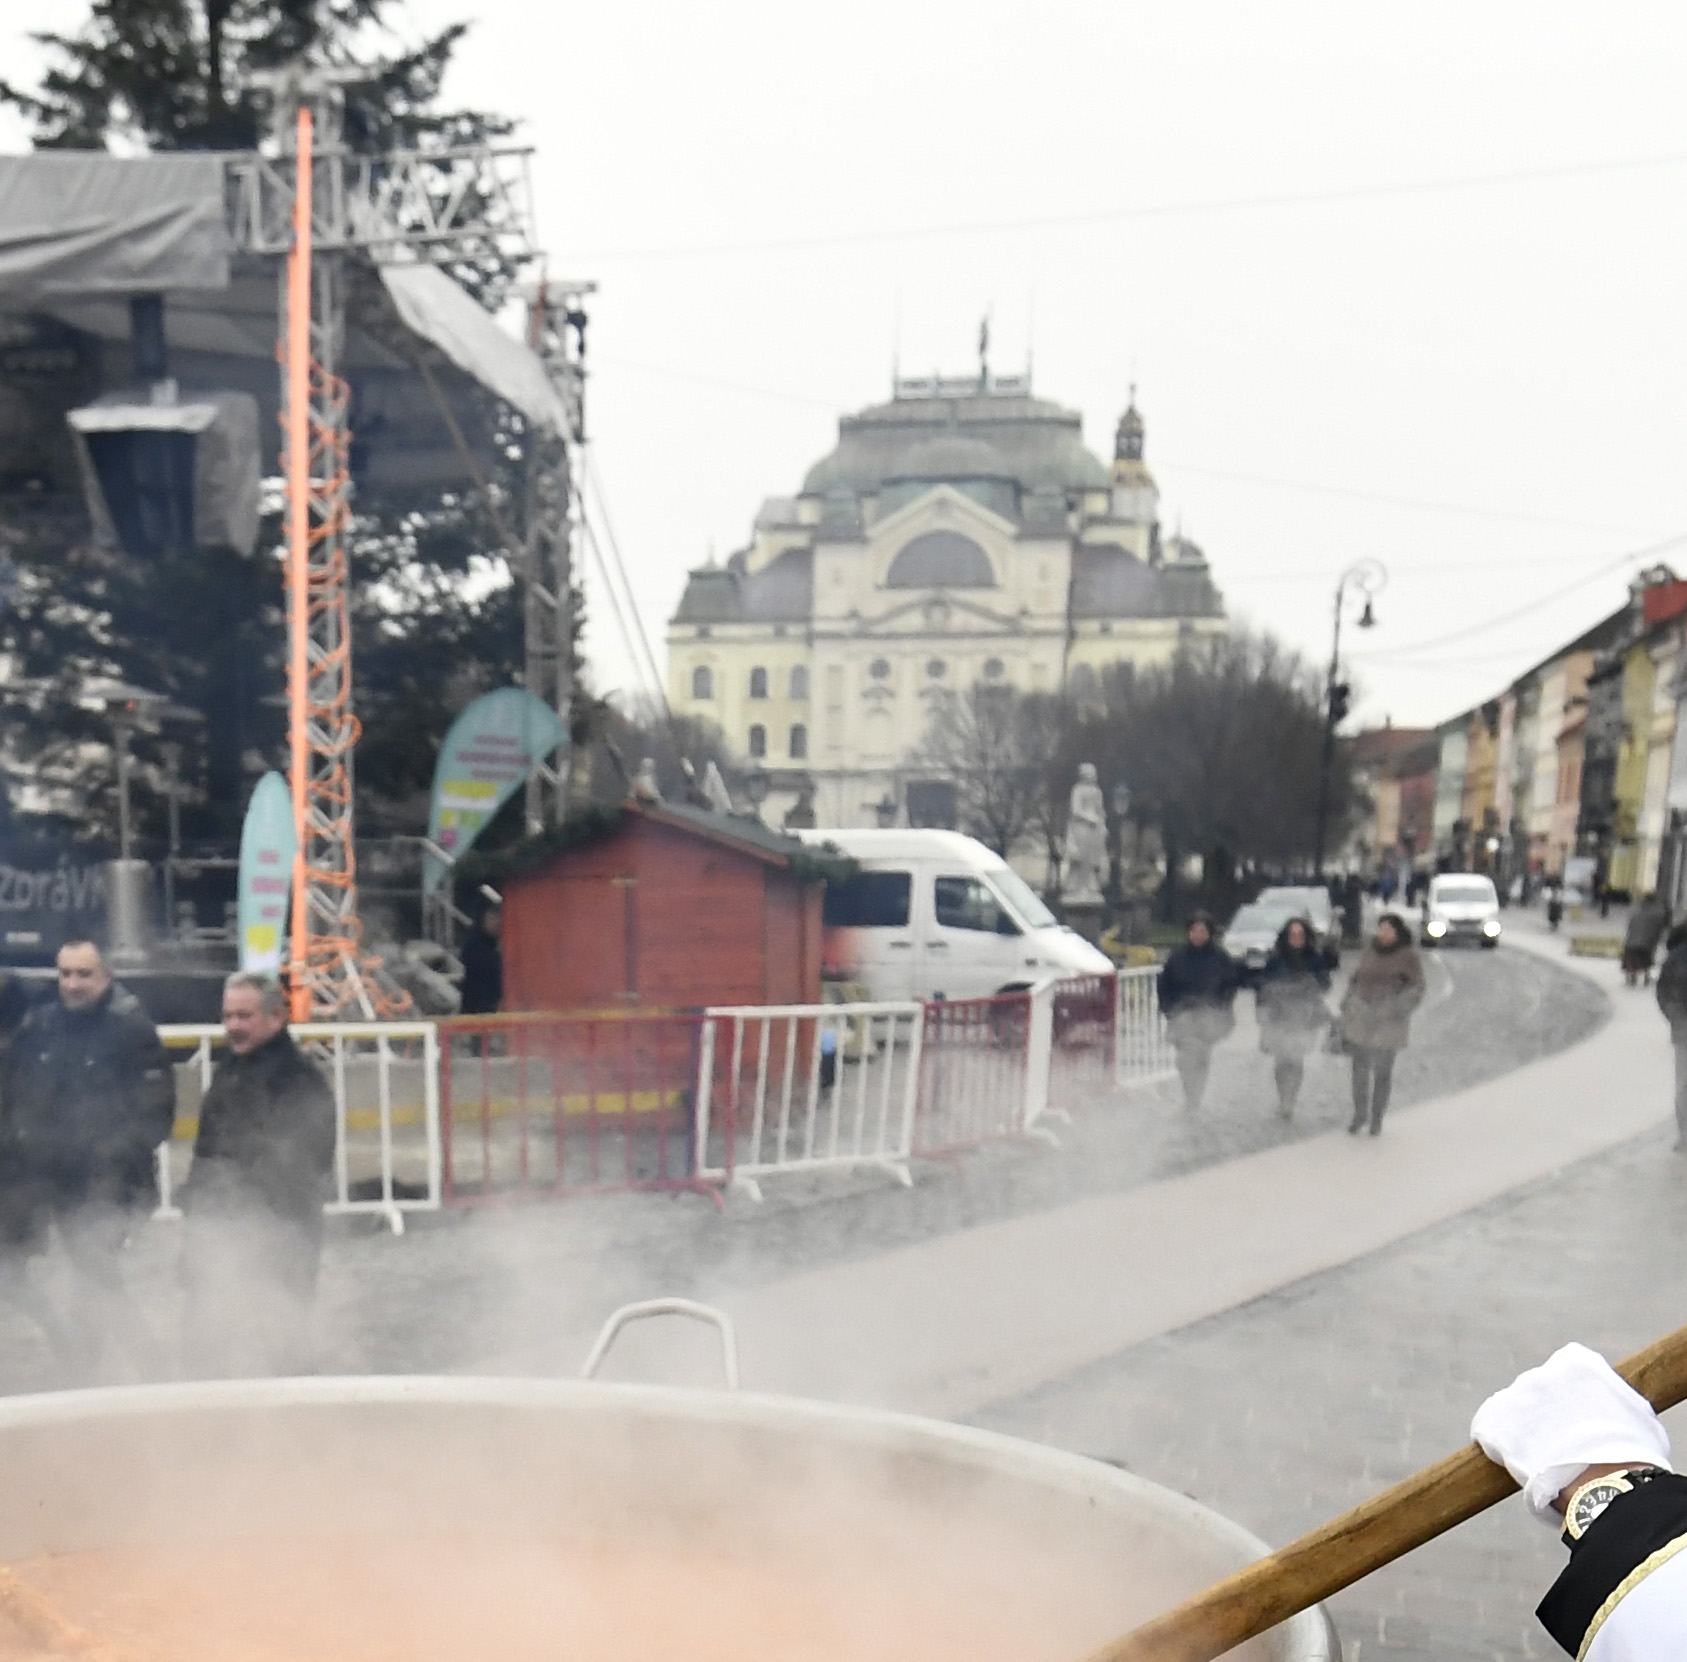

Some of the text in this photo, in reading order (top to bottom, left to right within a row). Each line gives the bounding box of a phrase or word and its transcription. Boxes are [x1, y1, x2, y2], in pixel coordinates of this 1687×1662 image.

[1579, 1504, 1591, 1514] 2
[1585, 1494, 1597, 1506] 3
[1597, 1489, 1607, 1501] 4
